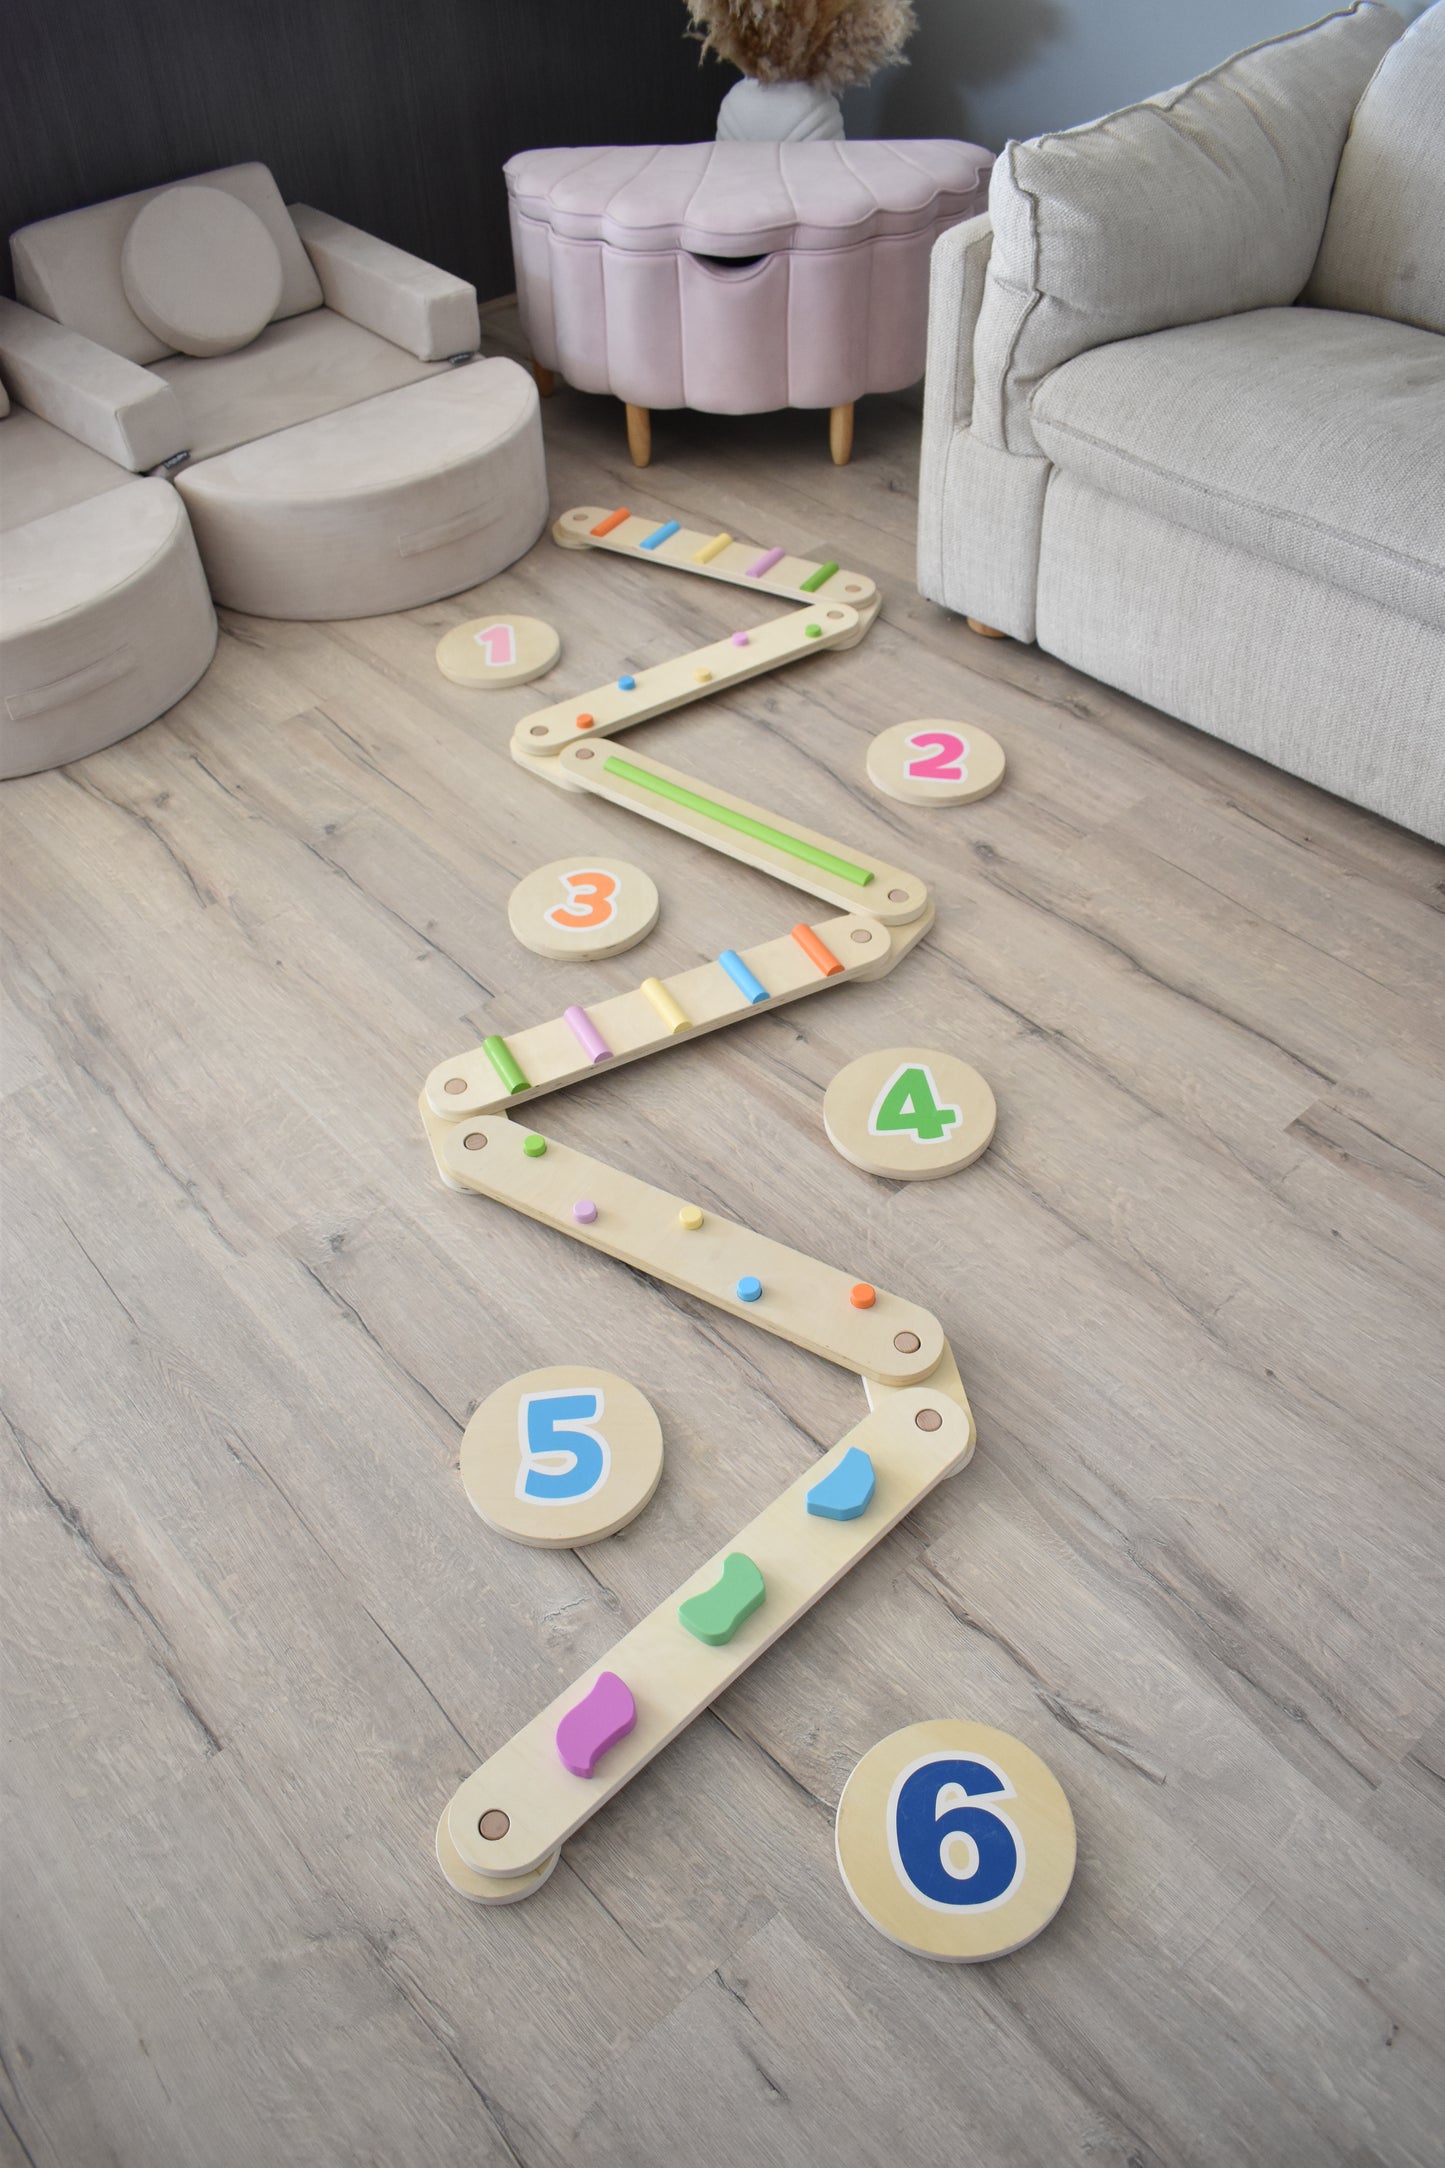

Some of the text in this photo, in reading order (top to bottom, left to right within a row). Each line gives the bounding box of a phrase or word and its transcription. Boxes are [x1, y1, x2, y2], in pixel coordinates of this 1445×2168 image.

[478, 626, 513, 665] 1
[906, 731, 967, 782] 2
[547, 870, 618, 931] 3
[872, 1066, 959, 1141] 4
[519, 1391, 608, 1503] 5
[891, 1756, 1022, 1910] 6
